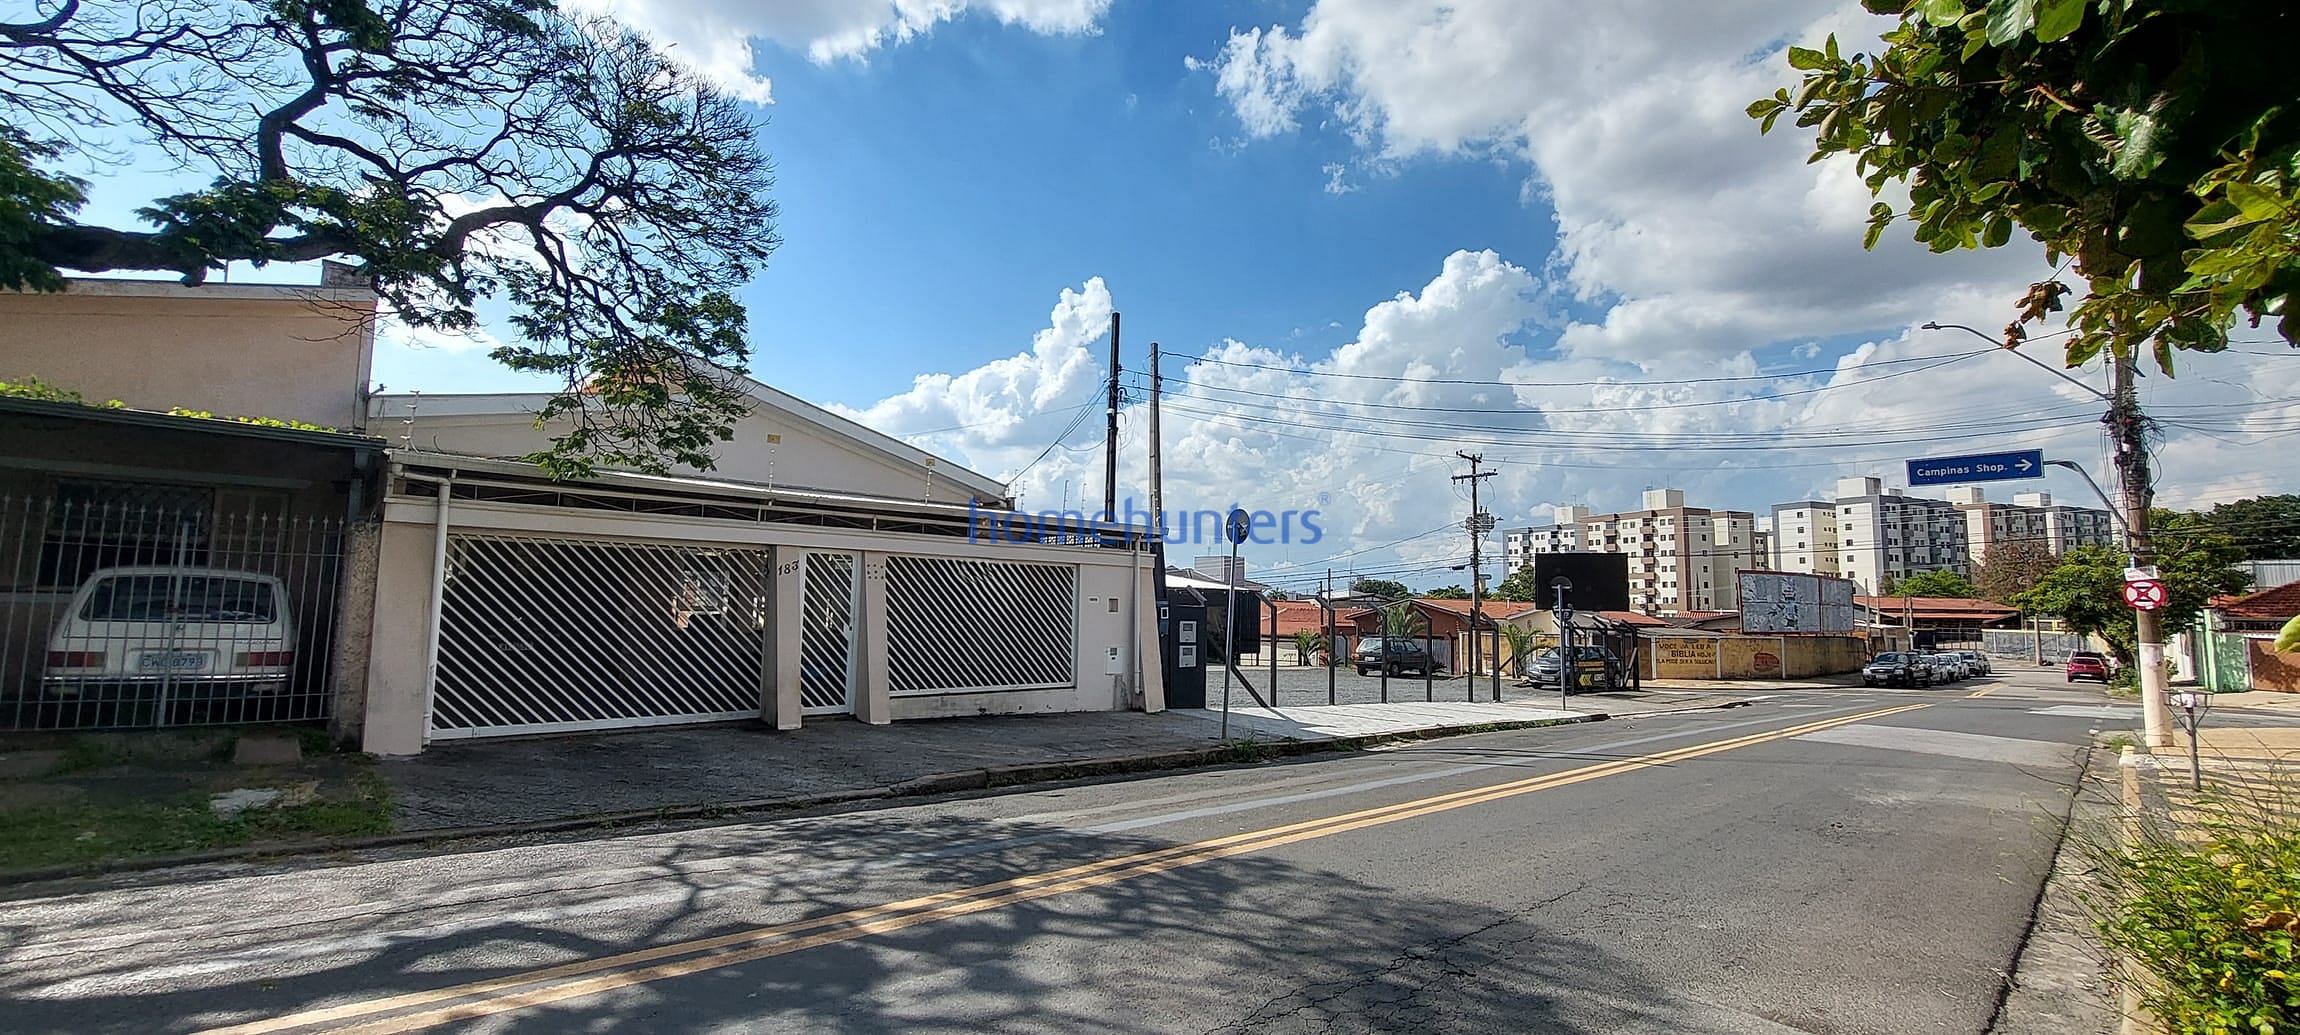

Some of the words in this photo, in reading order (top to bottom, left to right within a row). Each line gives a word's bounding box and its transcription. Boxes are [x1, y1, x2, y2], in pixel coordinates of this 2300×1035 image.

[1916, 466, 1970, 478] Campinas
[1976, 464, 2008, 474] Shop.
[779, 560, 799, 576] 183
